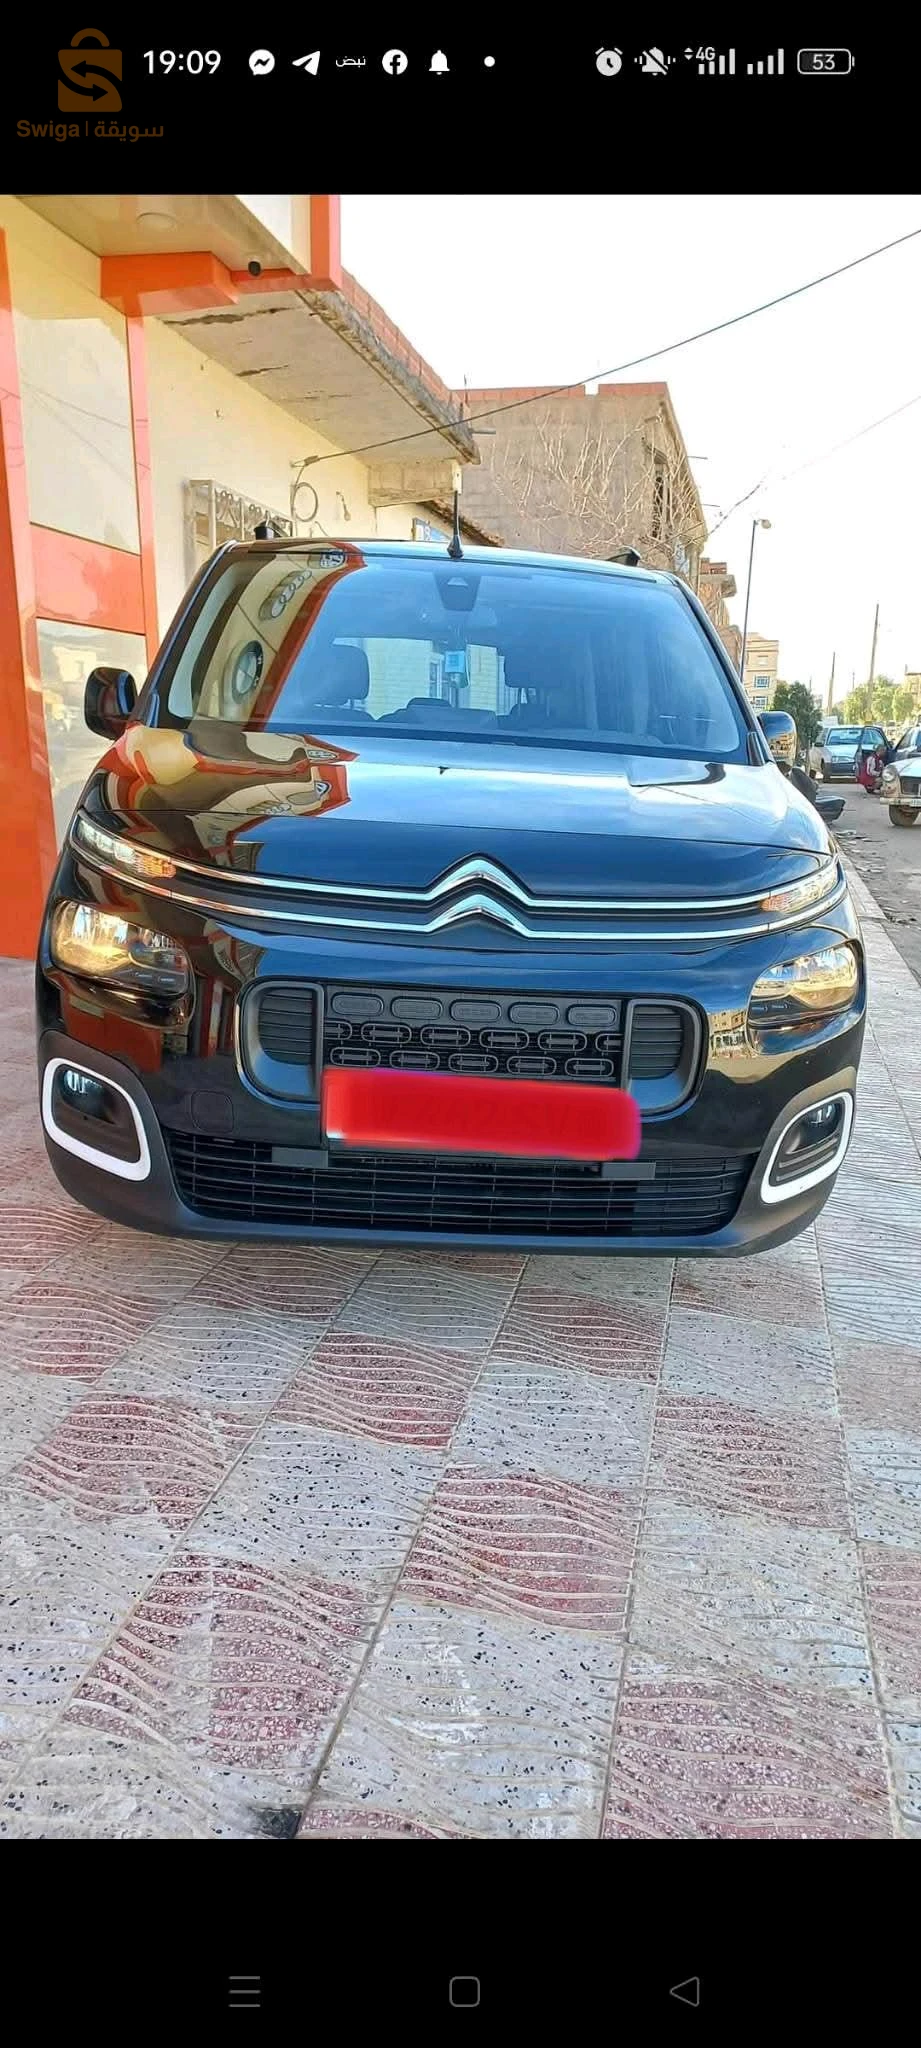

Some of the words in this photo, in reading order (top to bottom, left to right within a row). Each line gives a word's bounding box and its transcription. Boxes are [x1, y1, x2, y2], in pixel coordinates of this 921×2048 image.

[695, 47, 716, 61] 4G
[143, 50, 222, 75] 19:09
[335, 55, 367, 69] نبض
[811, 54, 836, 71] 53
